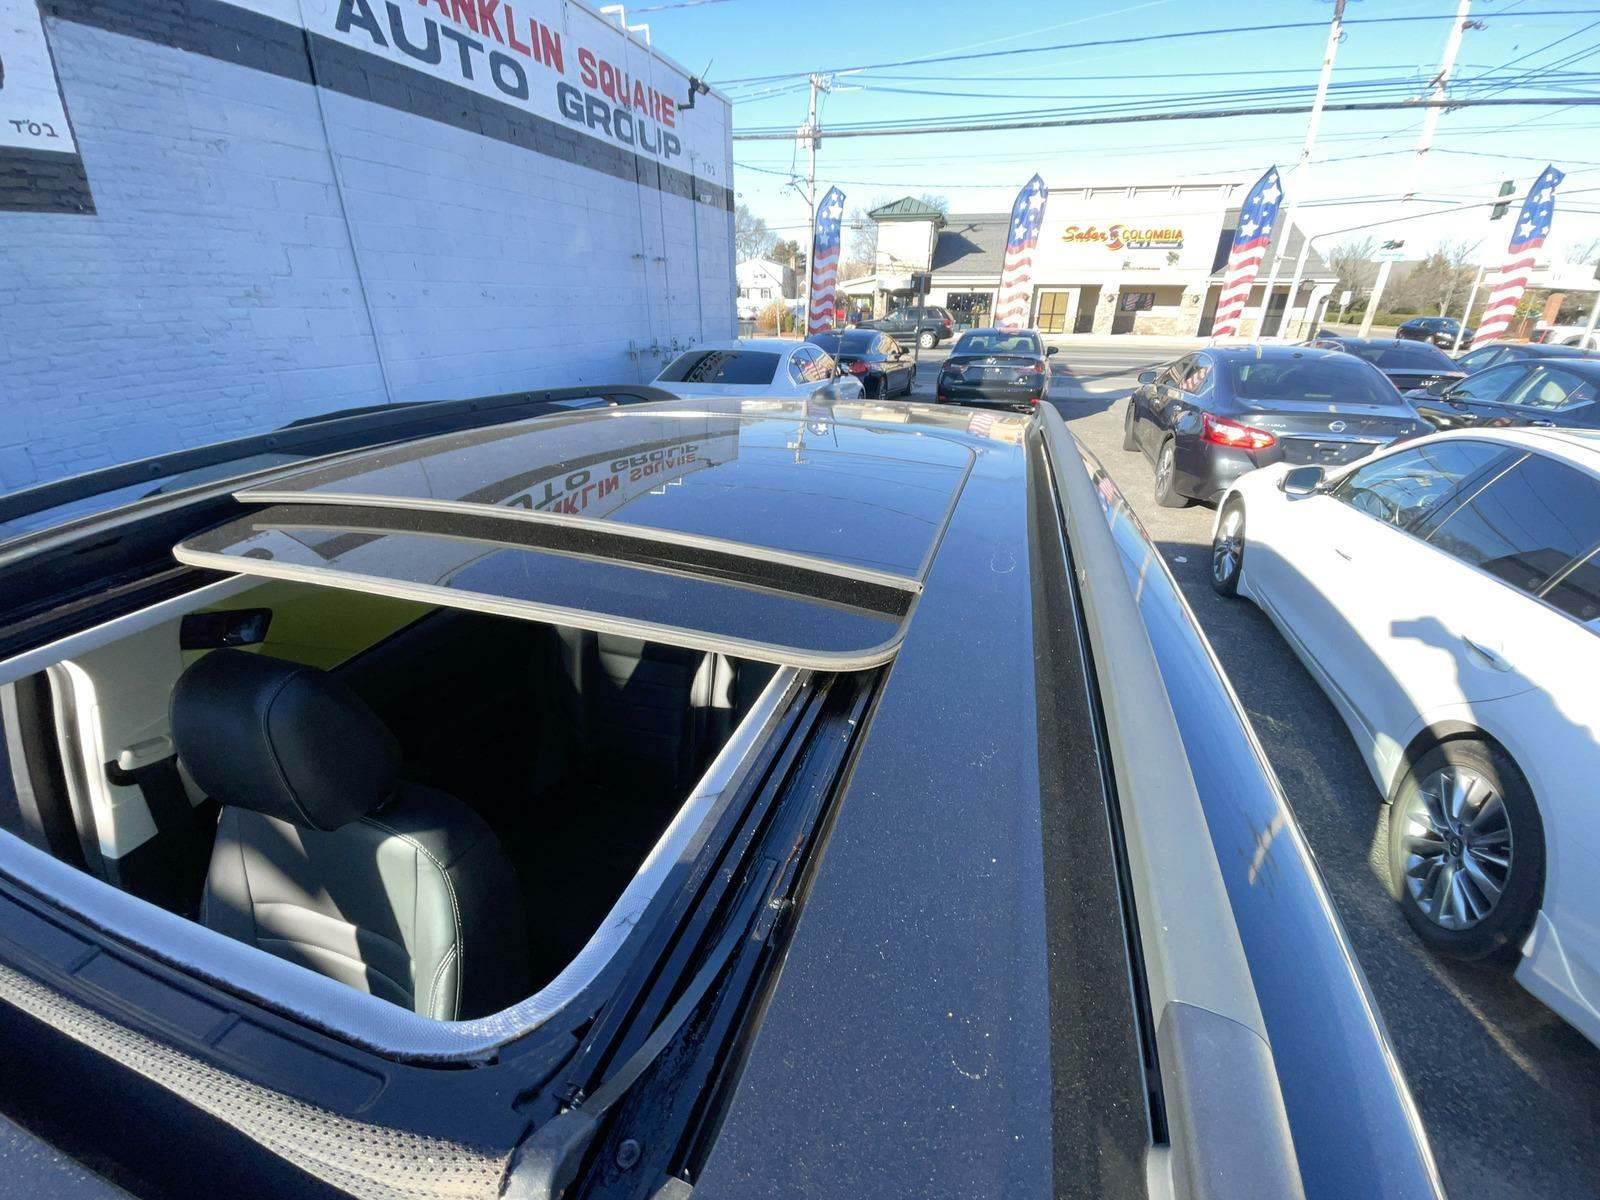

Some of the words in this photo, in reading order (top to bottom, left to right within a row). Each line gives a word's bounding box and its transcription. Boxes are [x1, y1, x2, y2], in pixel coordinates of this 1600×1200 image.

[335, 0, 529, 100] AUTO
[557, 81, 681, 159] GROUP
[418, 0, 564, 75] NKLIN
[578, 47, 675, 128] SQUARE
[1062, 226, 1108, 242] Sabor
[1122, 229, 1183, 241] COLOMBIA
